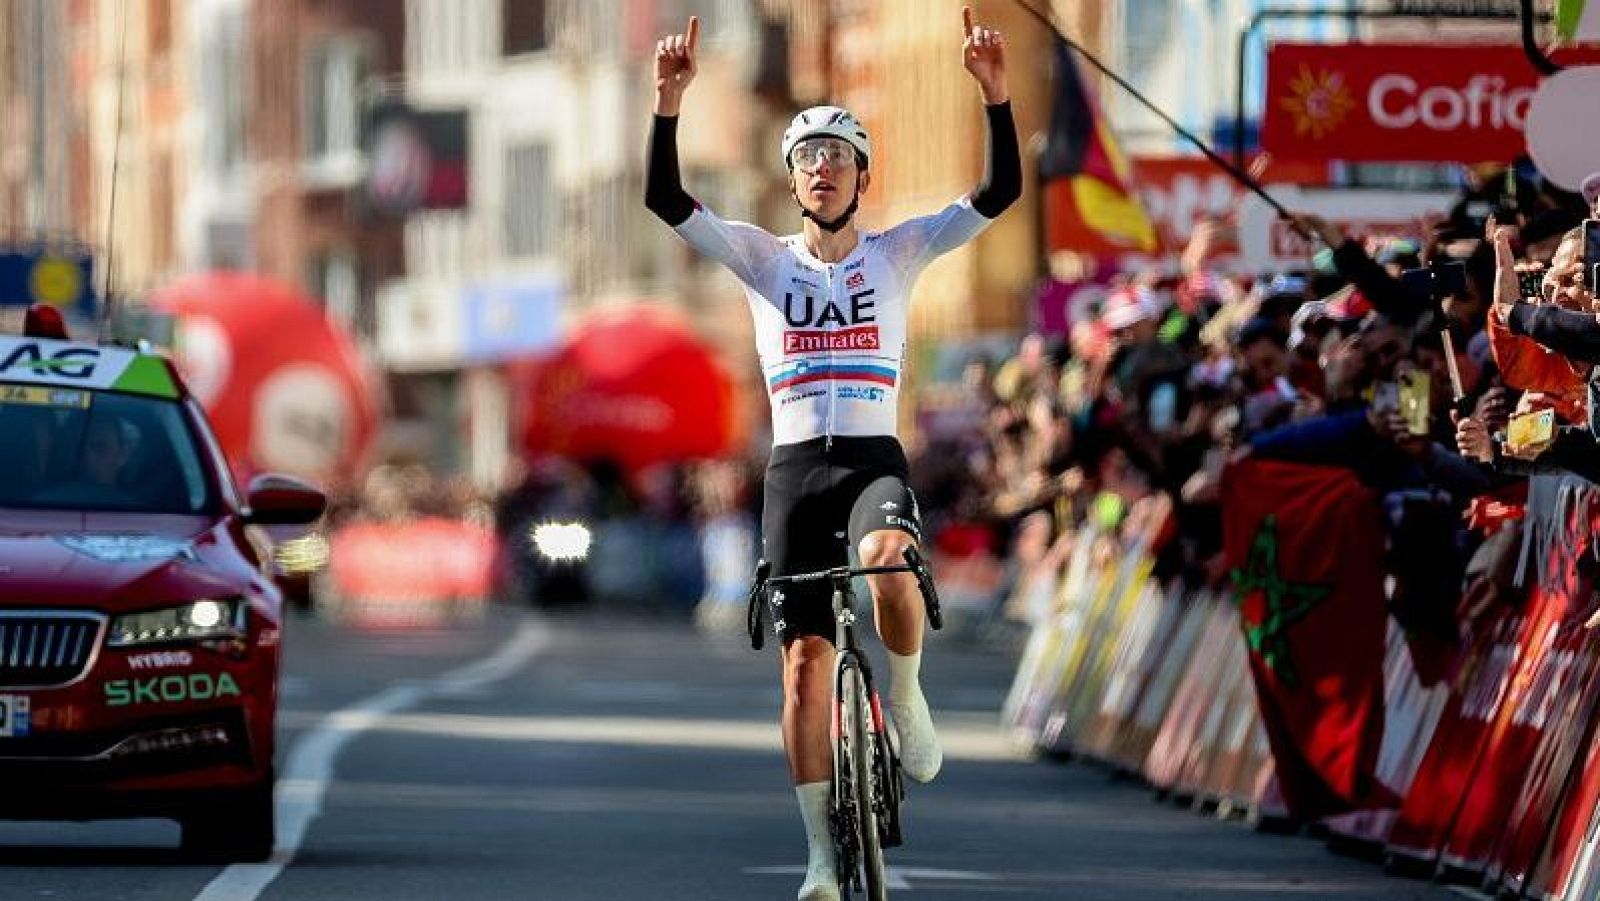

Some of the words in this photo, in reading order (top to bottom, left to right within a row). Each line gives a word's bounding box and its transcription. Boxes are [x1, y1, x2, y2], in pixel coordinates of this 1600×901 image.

[784, 288, 875, 328] UAE
[785, 331, 877, 351] Emirates
[0, 343, 101, 378] AG
[127, 651, 193, 668] HYBRID
